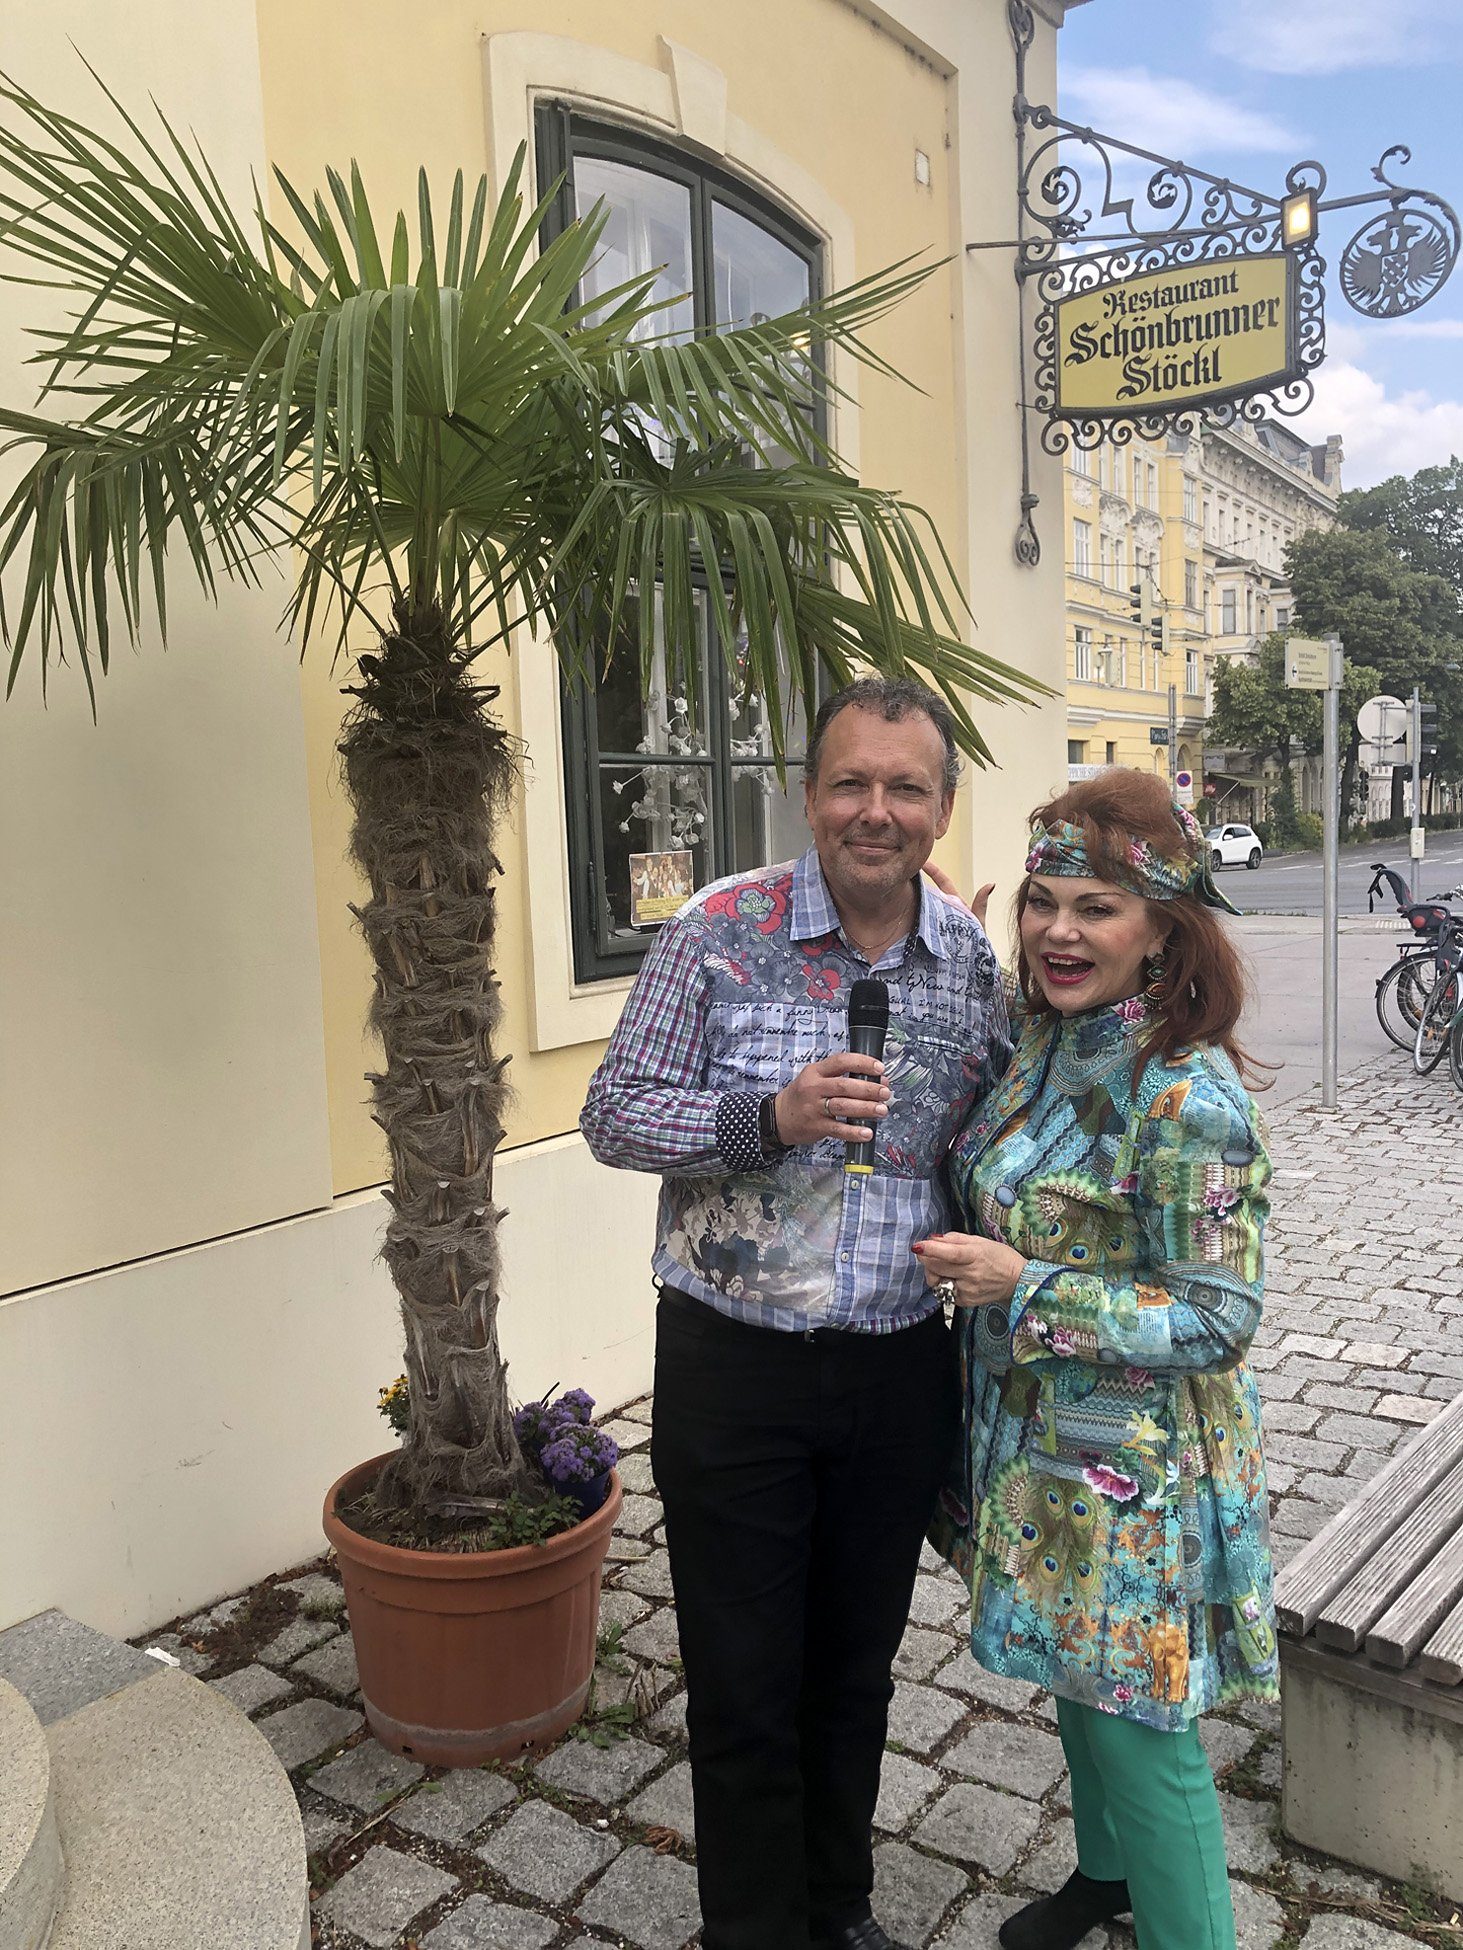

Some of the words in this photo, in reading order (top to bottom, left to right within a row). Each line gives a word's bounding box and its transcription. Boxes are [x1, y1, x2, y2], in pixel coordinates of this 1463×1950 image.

[1103, 267, 1239, 319] Restaurant
[1064, 297, 1280, 368] Schönbrunner
[1116, 342, 1222, 400] Stöckl
